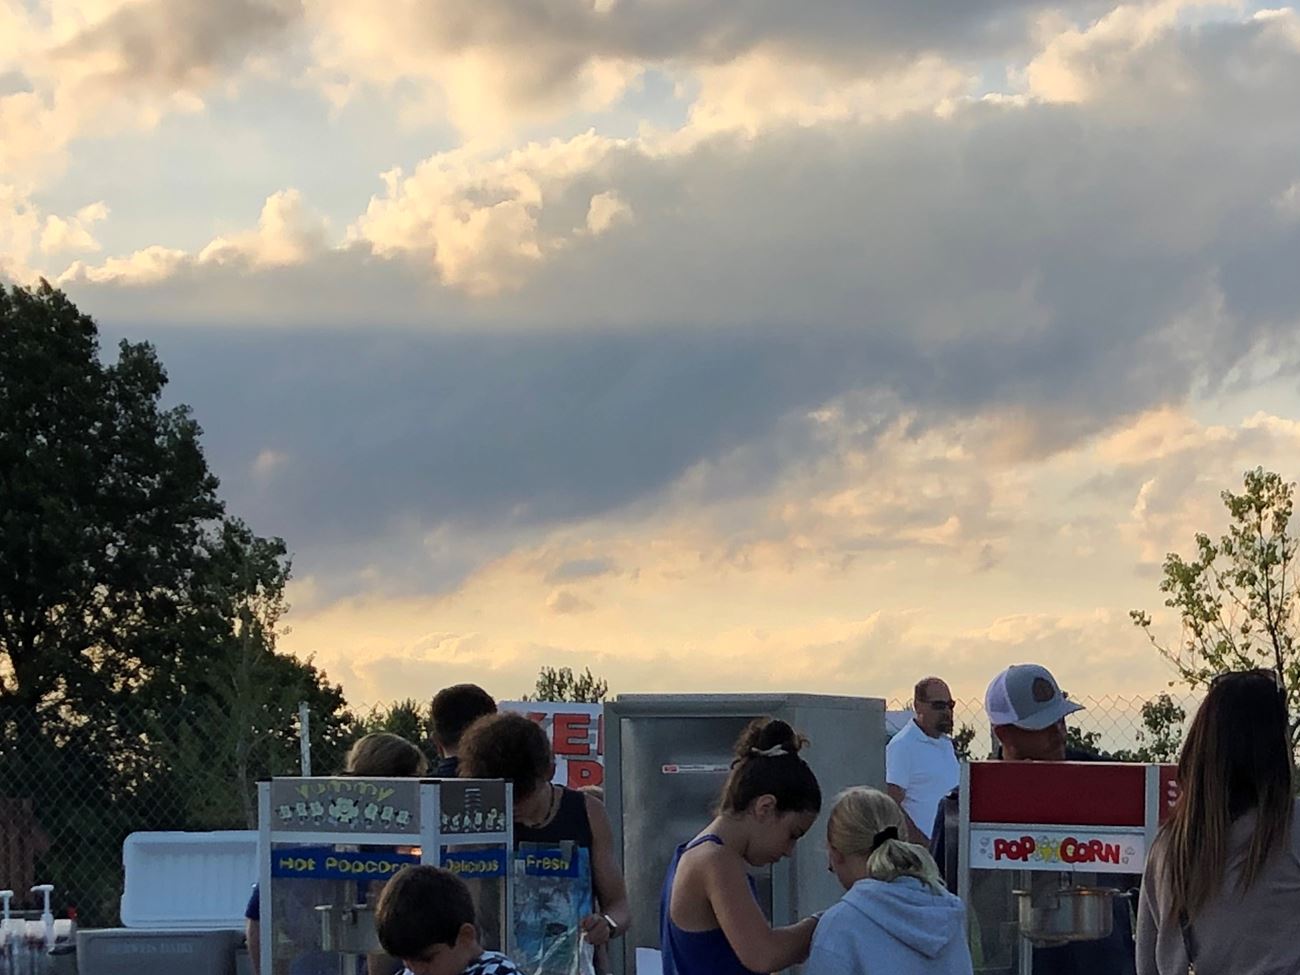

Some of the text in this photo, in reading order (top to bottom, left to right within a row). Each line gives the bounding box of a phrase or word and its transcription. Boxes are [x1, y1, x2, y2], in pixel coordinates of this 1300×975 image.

[993, 836, 1121, 864] POP CORN
[280, 857, 316, 871] Hot
